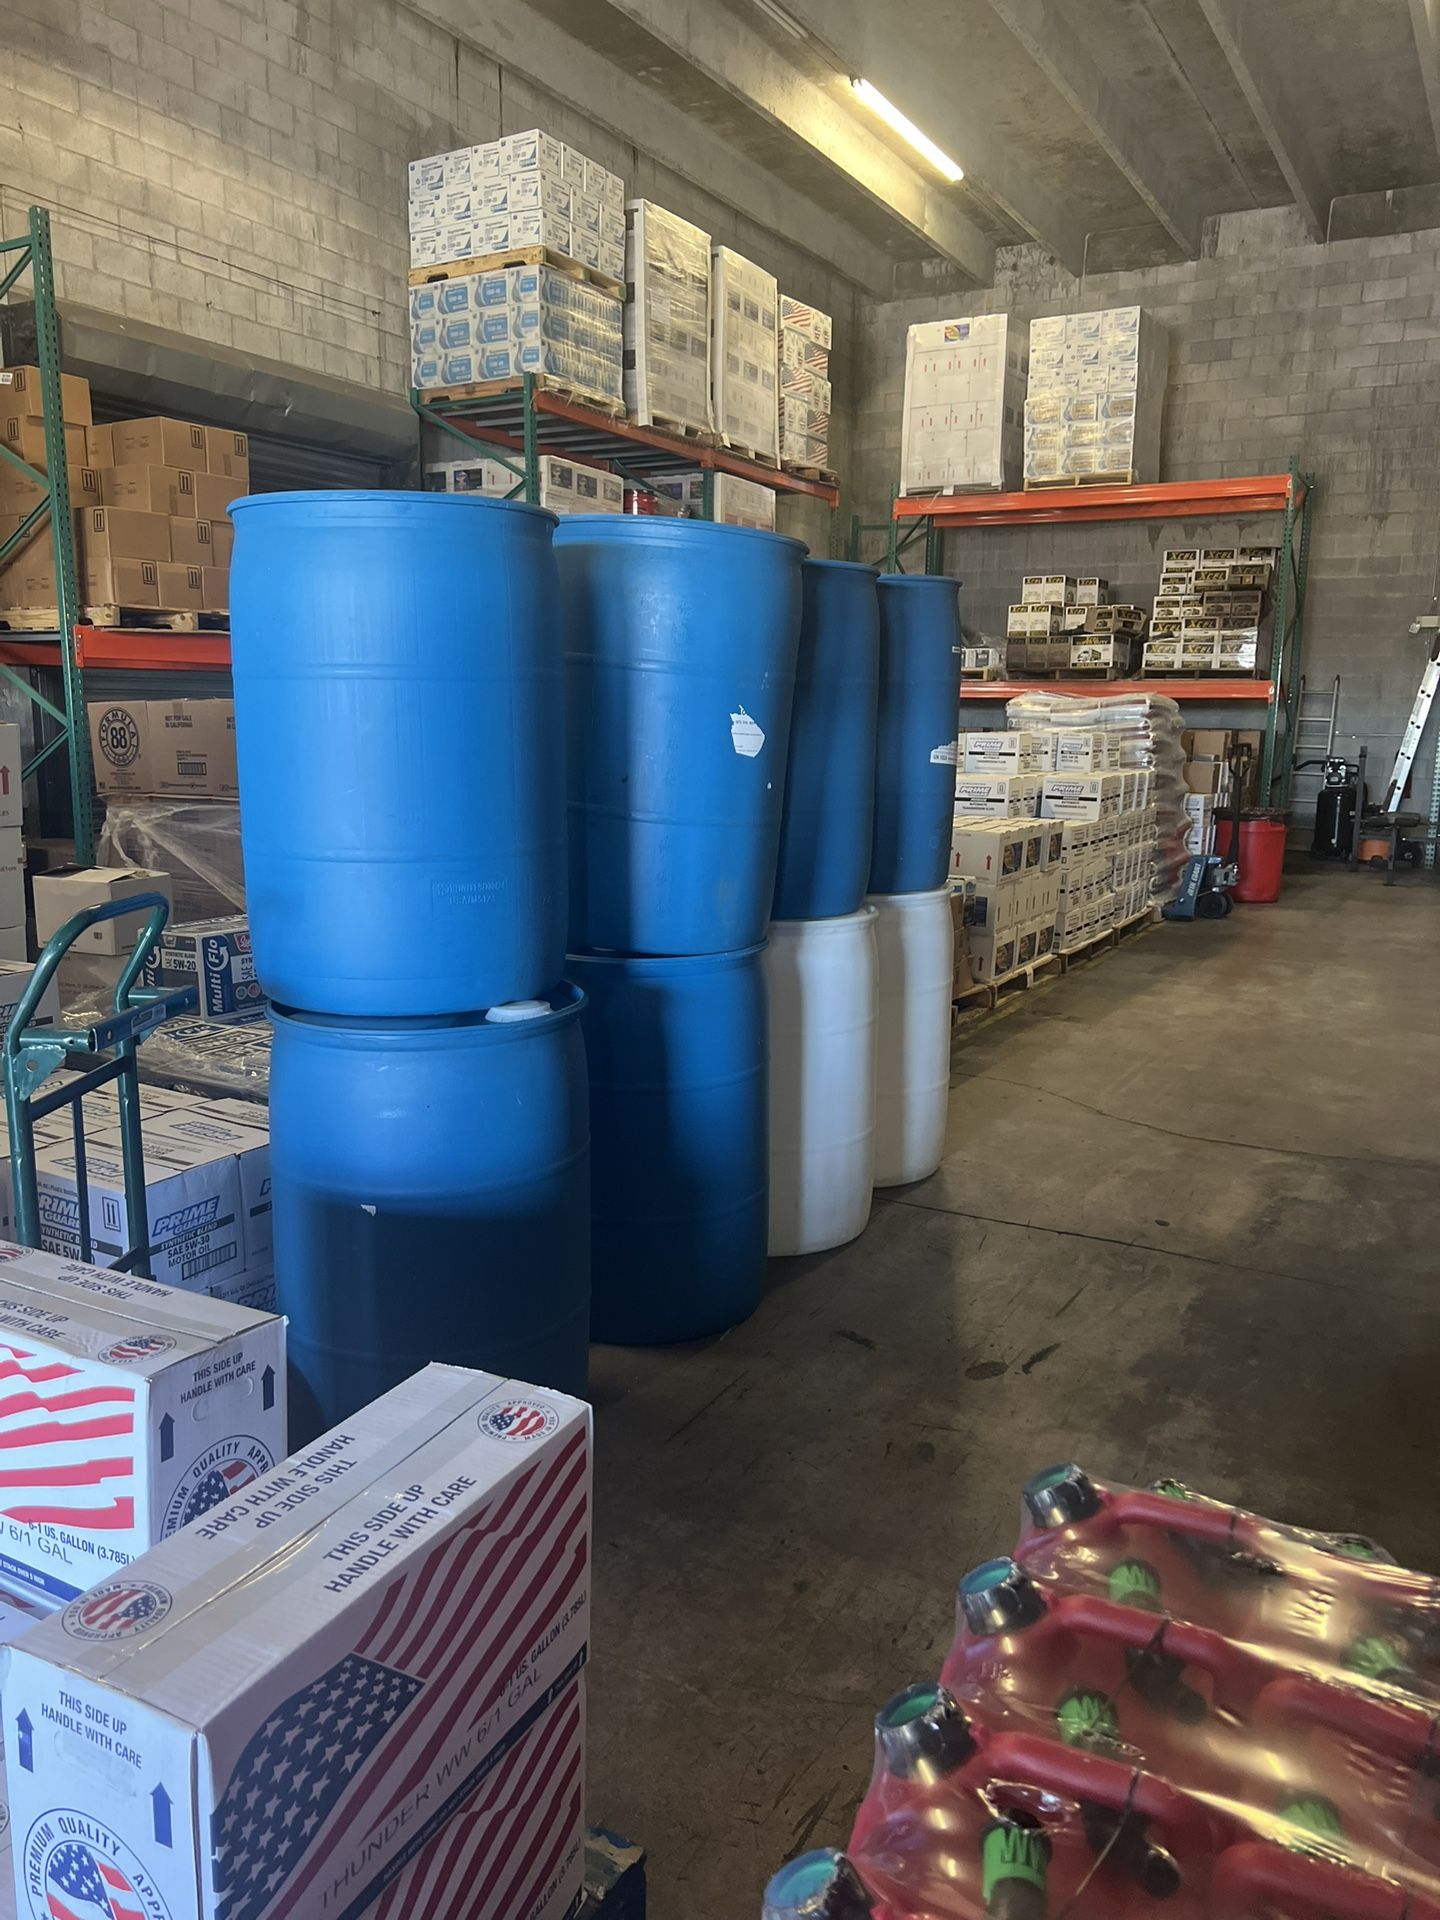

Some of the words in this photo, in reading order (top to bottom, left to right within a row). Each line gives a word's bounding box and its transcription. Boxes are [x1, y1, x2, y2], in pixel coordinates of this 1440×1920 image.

[110, 726, 128, 750] 88
[173, 958, 196, 971] 5W-20
[208, 940, 220, 964] Flo
[210, 972, 223, 1012] Multi
[44, 1210, 80, 1228] GUAR
[153, 1196, 220, 1238] PRIME
[174, 1212, 216, 1235] GUARD
[41, 1226, 74, 1242] YNTHETIC
[42, 1239, 60, 1256] SAE
[168, 1245, 184, 1260] SAE
[185, 1234, 210, 1252] 5W-30
[168, 1251, 198, 1268] MOTOR
[199, 1244, 211, 1256] OIL
[102, 1286, 134, 1300] THIS
[17, 1305, 52, 1319] SIDE
[46, 1312, 70, 1322] UP
[26, 1320, 66, 1340] CARE
[180, 1382, 212, 1404] HANDLE
[214, 1371, 235, 1388] WITH
[236, 1360, 256, 1378] CARE
[193, 1366, 212, 1384] THIS
[214, 1356, 232, 1374] SIDE
[232, 1352, 244, 1365] UP
[193, 1441, 240, 1478] QUALITY
[288, 1433, 356, 1479] HANDLE
[315, 1458, 358, 1486] THIS
[244, 1476, 296, 1507] WITH
[274, 1483, 320, 1512] SIDE
[196, 1506, 250, 1540] CARE
[255, 1510, 283, 1529] UP
[323, 1530, 370, 1562] THIS
[364, 1506, 407, 1532] SIDE
[403, 1483, 426, 1504] UP
[323, 1539, 398, 1594] HANDLE
[388, 1508, 439, 1540] WITH
[430, 1474, 478, 1508] CARE
[9, 1525, 31, 1547] 6/1
[38, 1537, 73, 1565] GAL
[60, 1531, 94, 1555] GALLON
[531, 1623, 560, 1663] GALLON
[58, 1690, 82, 1714] THIS
[85, 1704, 110, 1728] SIDE
[112, 1719, 127, 1736] UP
[41, 1703, 82, 1736] HANDLE
[85, 1726, 112, 1751] WITH
[114, 1742, 142, 1769] CARE
[321, 1784, 430, 1910] THUNDER
[508, 1670, 543, 1708] GAL
[30, 1822, 55, 1898] PREMIUM
[58, 1816, 120, 1856] QUALITY
